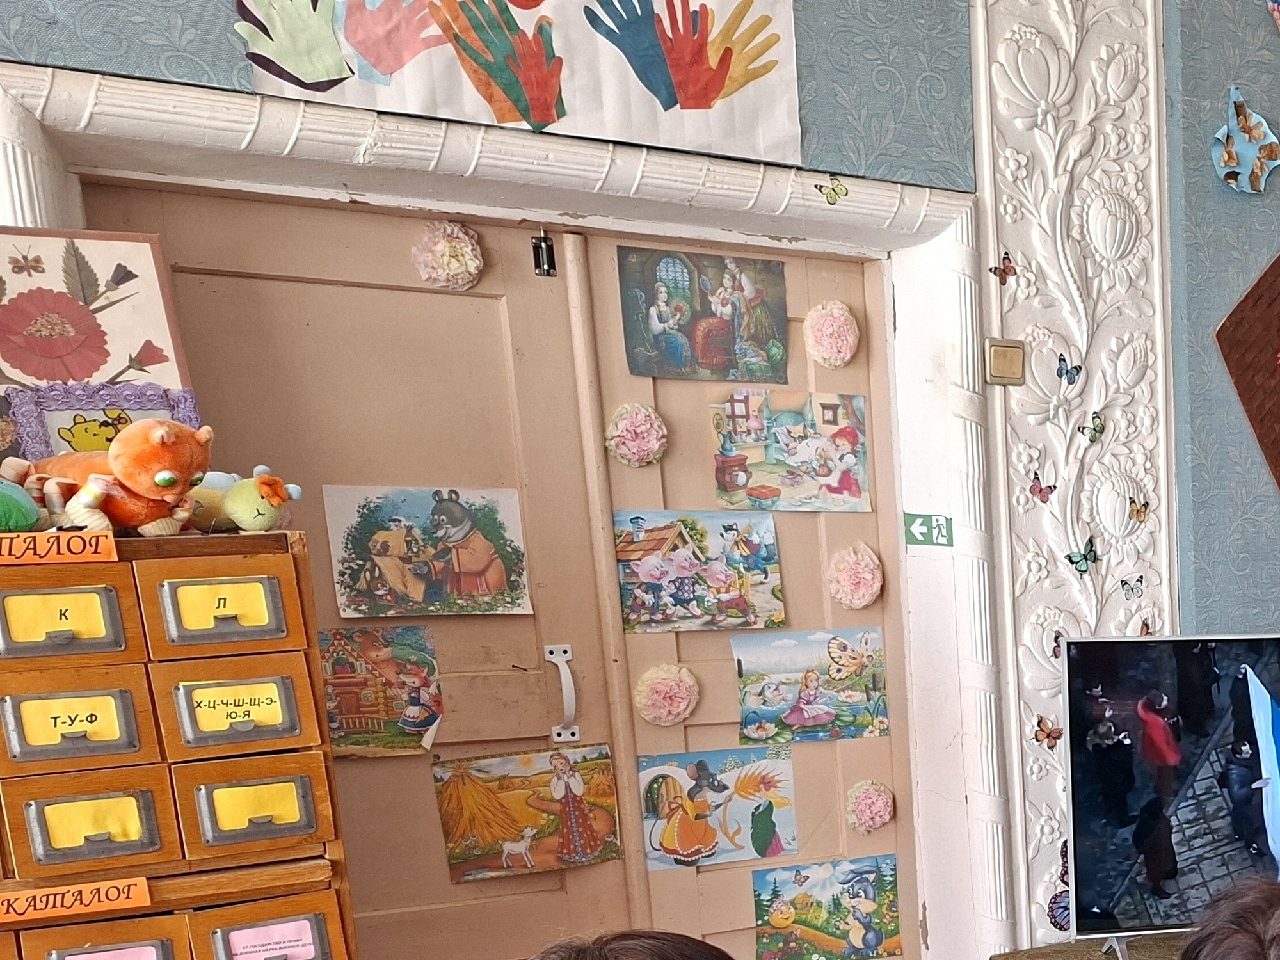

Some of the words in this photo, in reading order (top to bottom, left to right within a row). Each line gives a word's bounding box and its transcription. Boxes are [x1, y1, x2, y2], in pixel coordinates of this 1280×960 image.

[215, 597, 228, 610] Л
[58, 607, 70, 622] К
[50, 713, 98, 729] Т-У-Ф
[225, 710, 251, 721] Ю-Я
[0, 883, 138, 917] КАТАЛОГ
